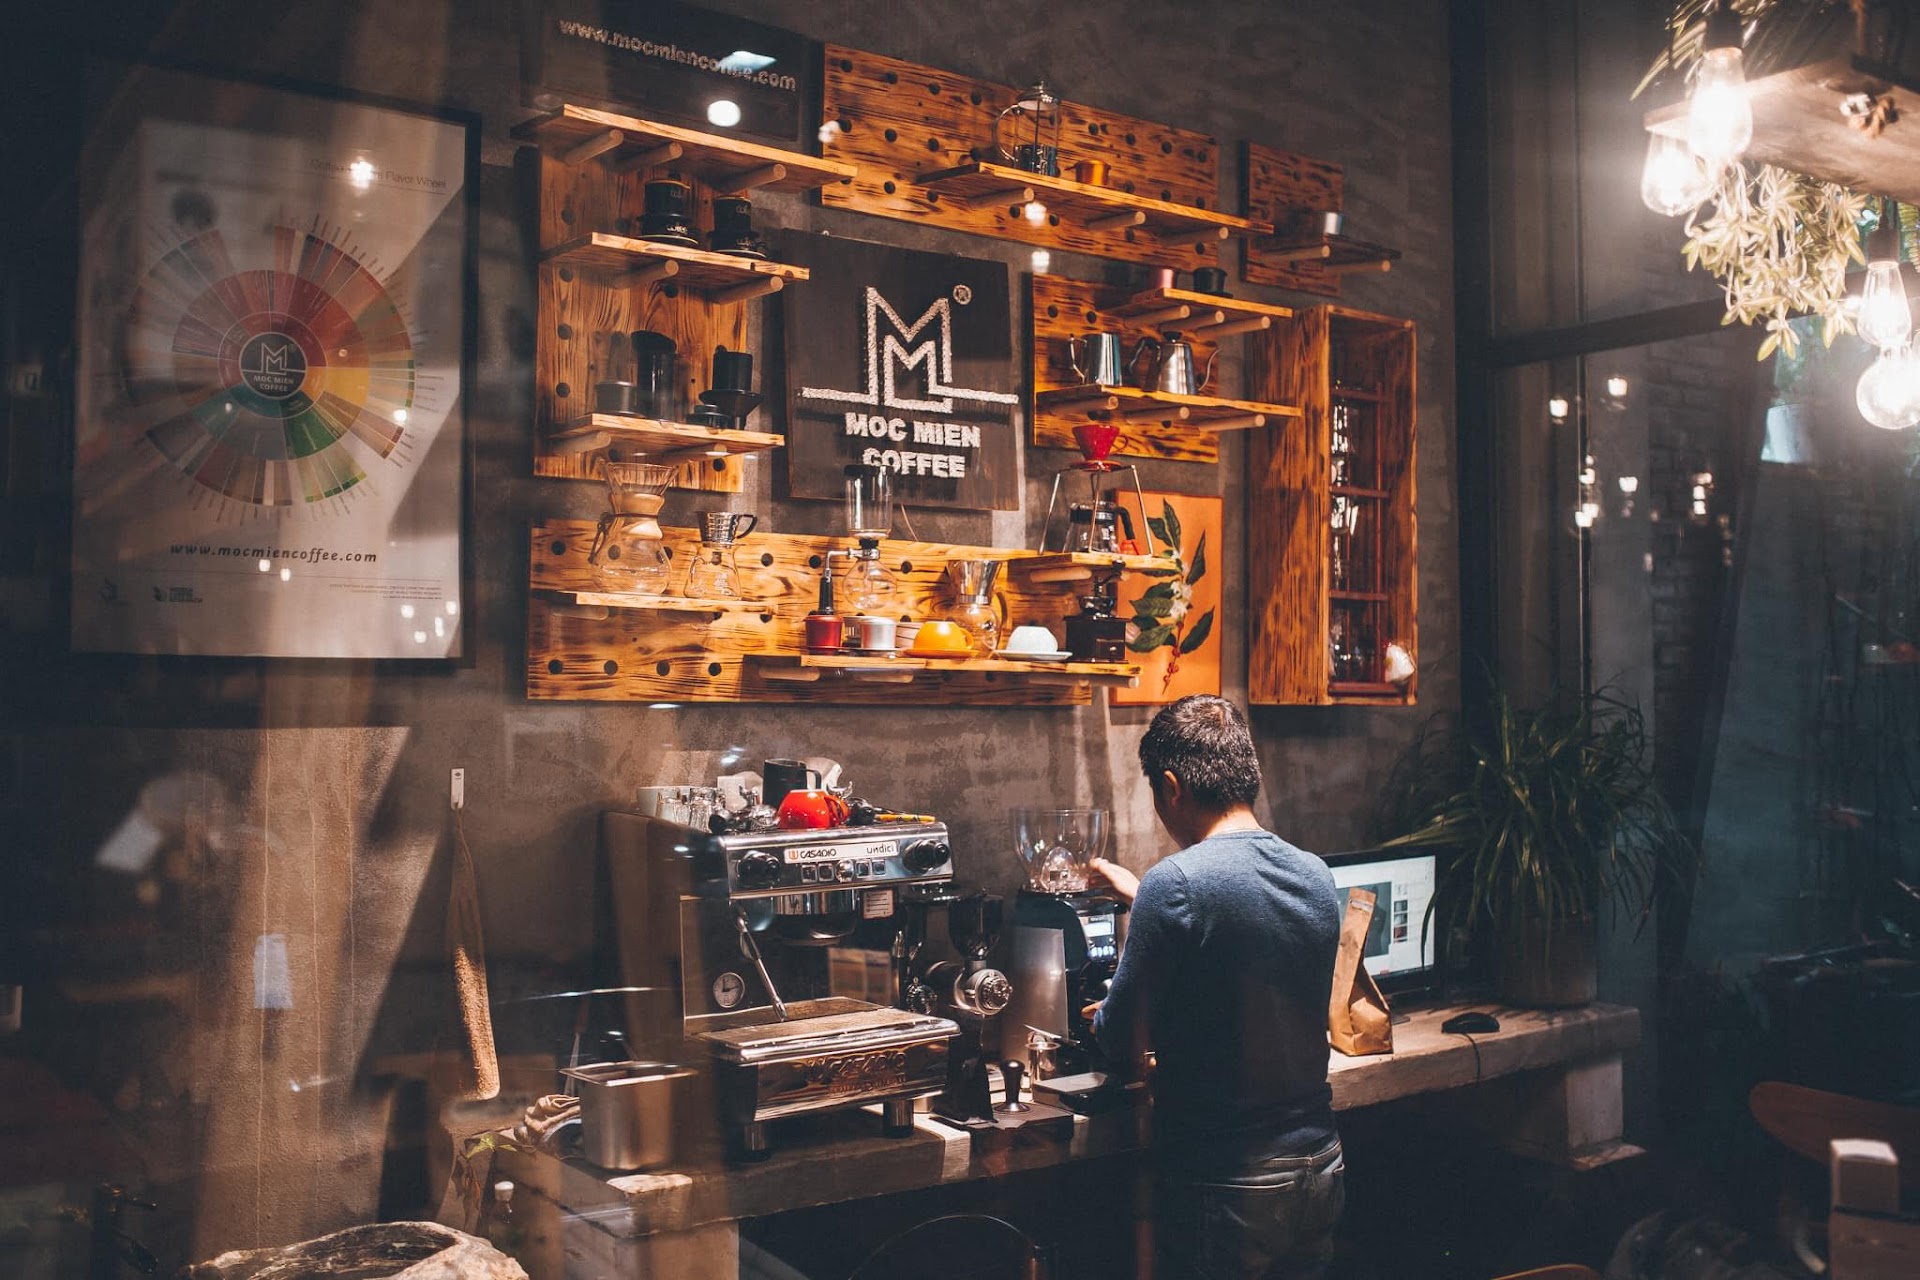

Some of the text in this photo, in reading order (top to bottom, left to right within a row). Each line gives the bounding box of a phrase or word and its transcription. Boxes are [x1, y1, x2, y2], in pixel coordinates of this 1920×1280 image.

[253, 375, 294, 385] MOC MIEN
[260, 383, 288, 391] COFFEE
[845, 412, 981, 448] MOC MIEN
[862, 447, 966, 479] COFFEE
[170, 545, 377, 563] www.mocmiencoffee.com
[800, 843, 894, 859] CASADIO undici
